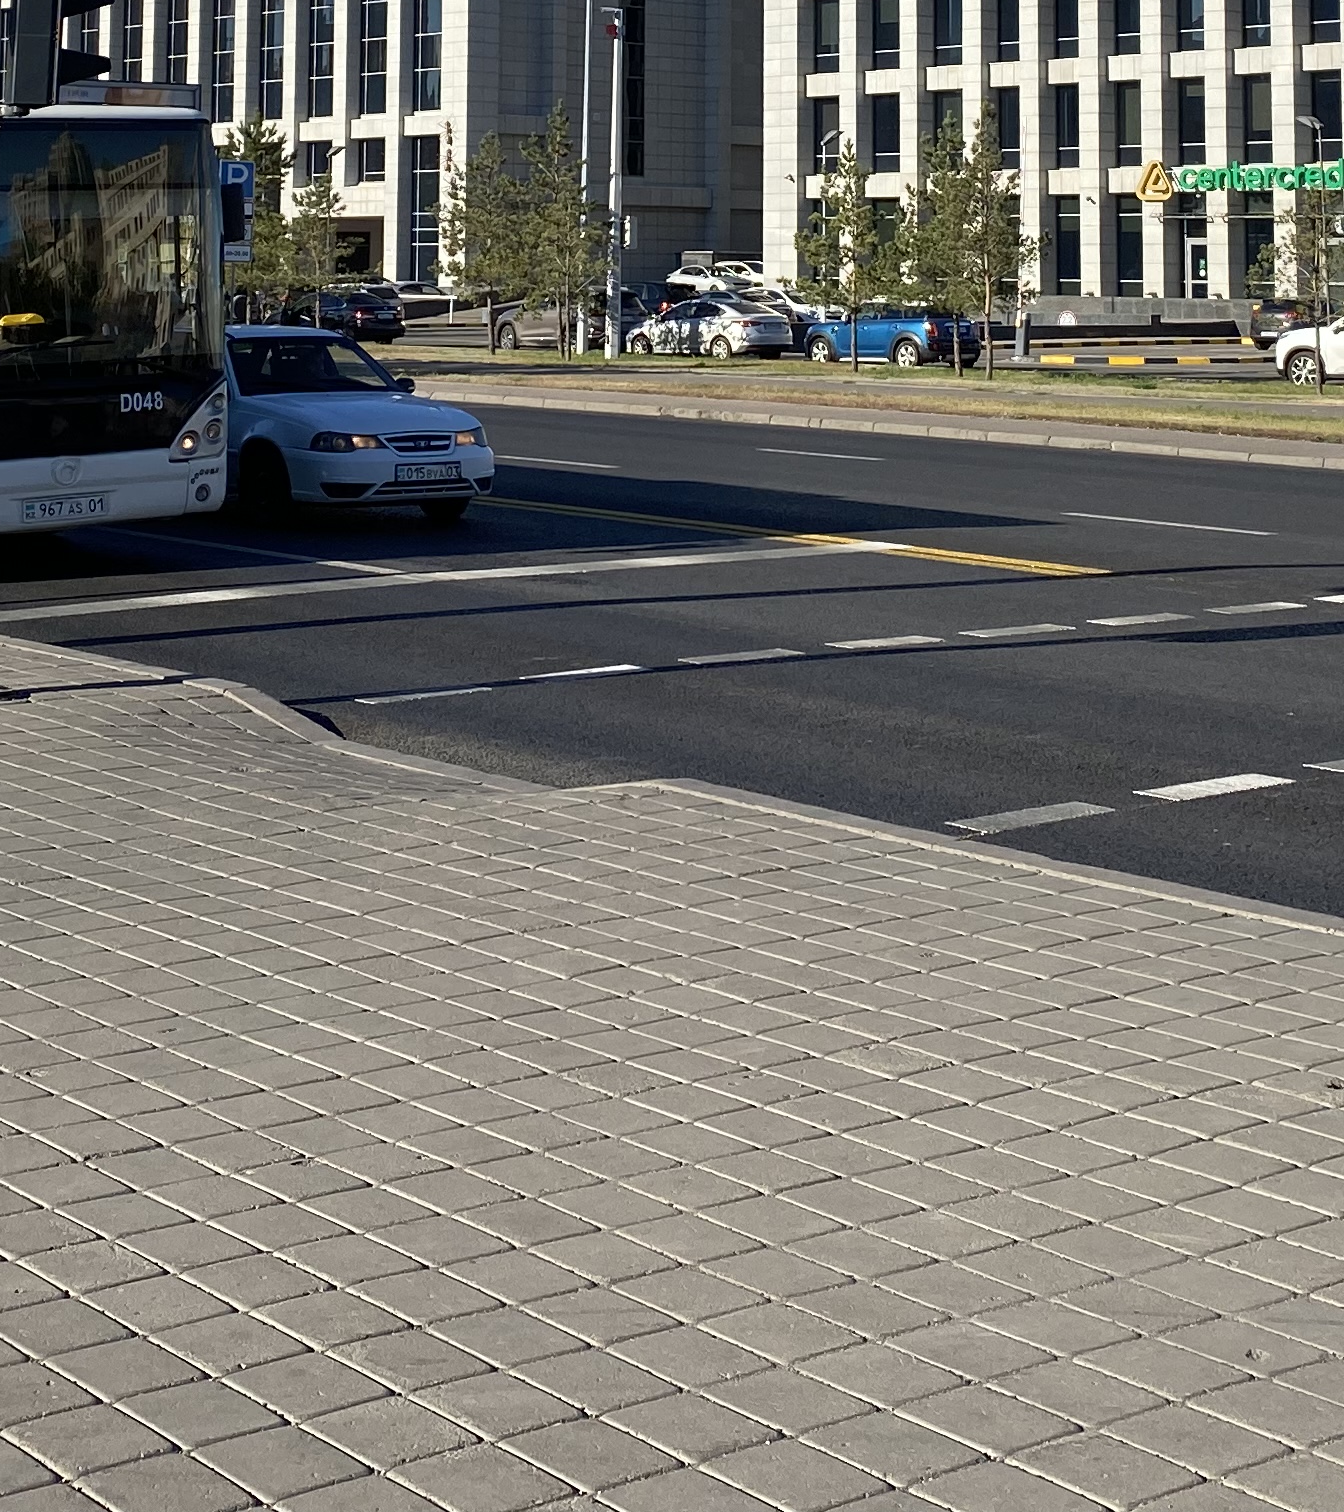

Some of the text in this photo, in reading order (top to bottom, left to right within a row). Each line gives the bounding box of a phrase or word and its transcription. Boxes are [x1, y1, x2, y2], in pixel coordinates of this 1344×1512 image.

[120, 391, 164, 413] D048
[406, 466, 425, 479] 015
[39, 497, 104, 518] 967 AS 01
